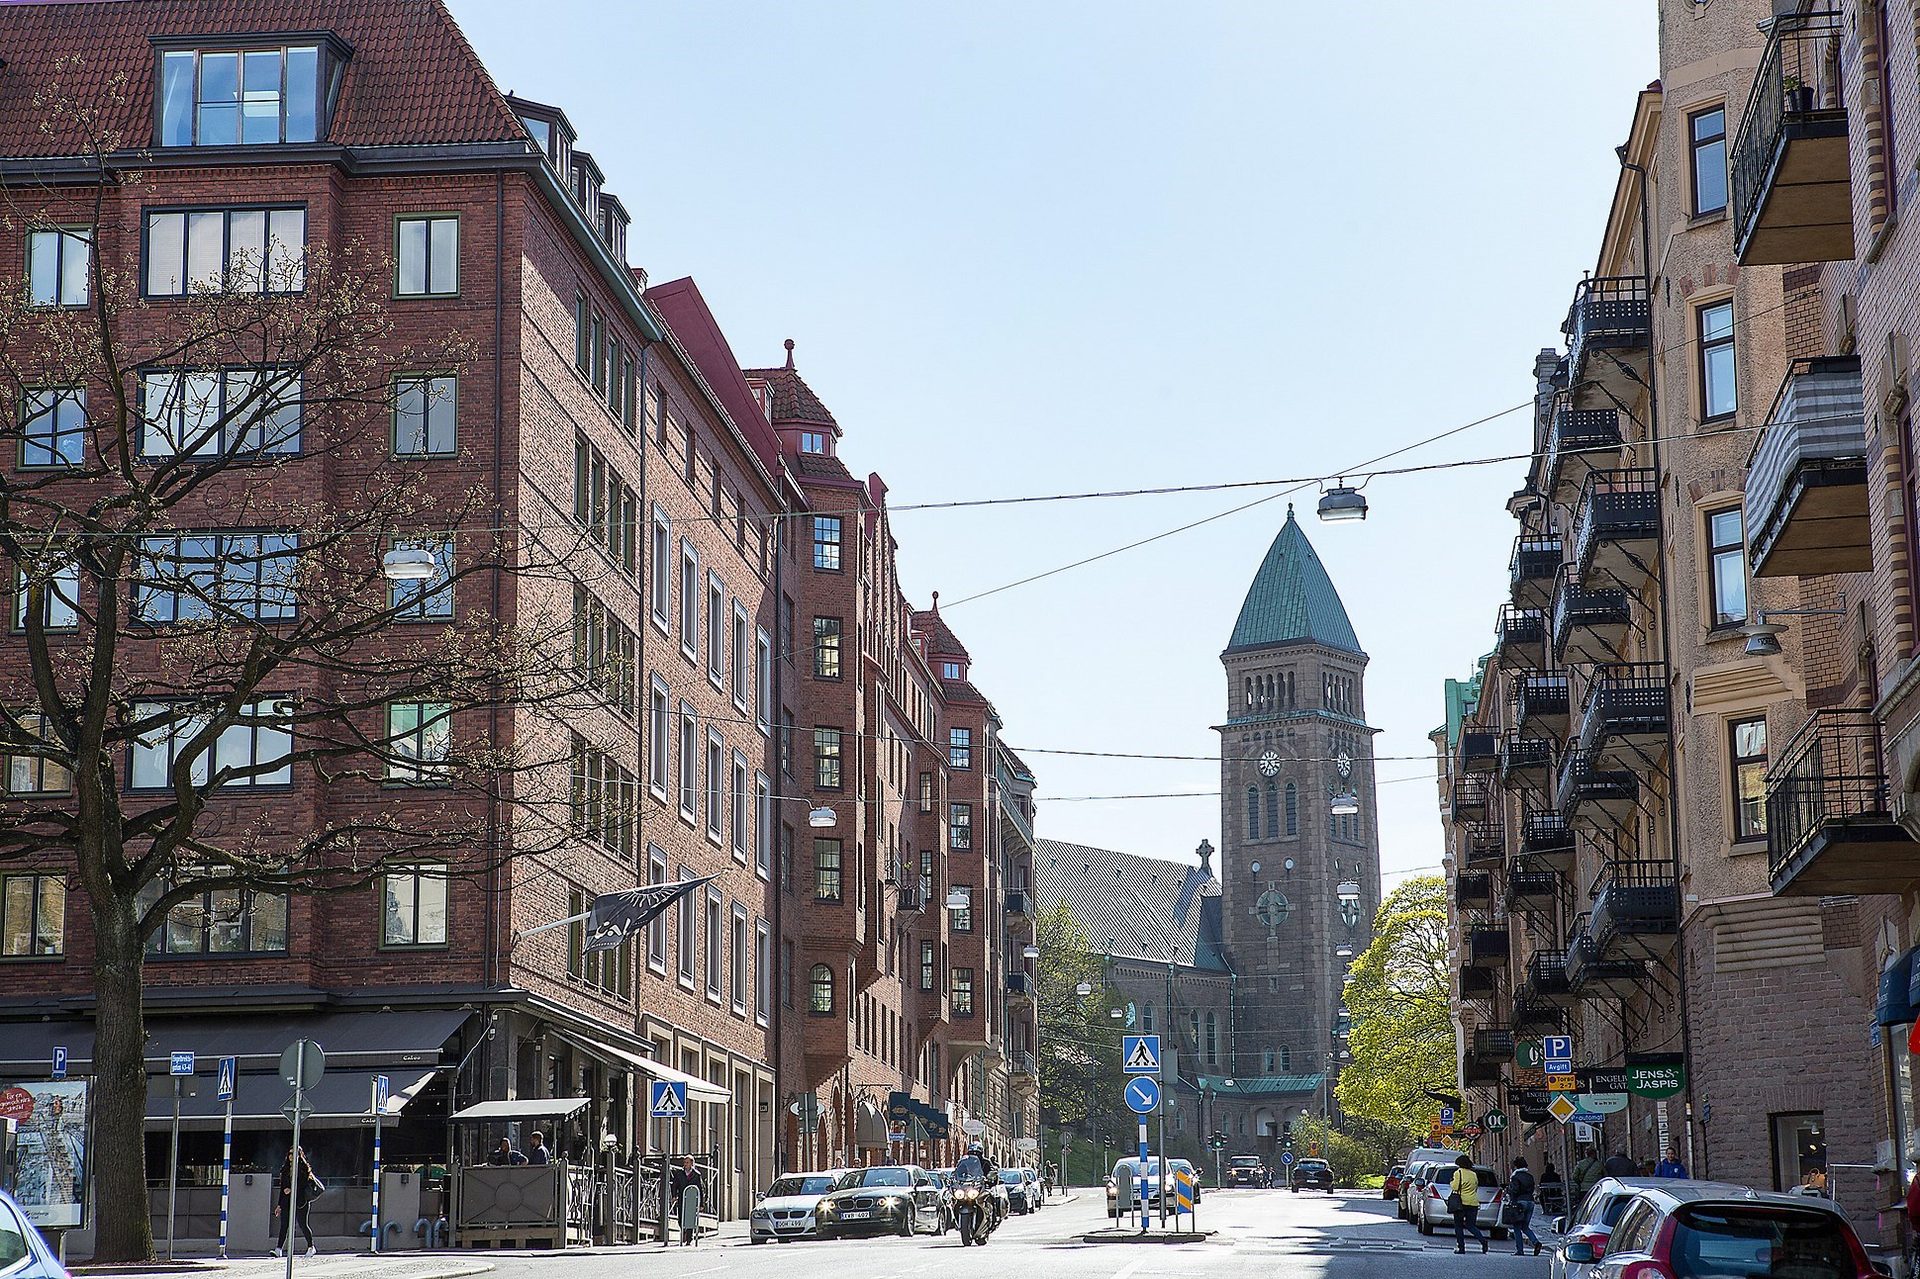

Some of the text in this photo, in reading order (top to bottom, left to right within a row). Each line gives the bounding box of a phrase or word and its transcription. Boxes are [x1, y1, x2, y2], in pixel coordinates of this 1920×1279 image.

[1552, 1039, 1565, 1056] P
[56, 1050, 64, 1069] P
[1636, 1079, 1679, 1089] JASPIS
[1443, 1109, 1450, 1118] P
